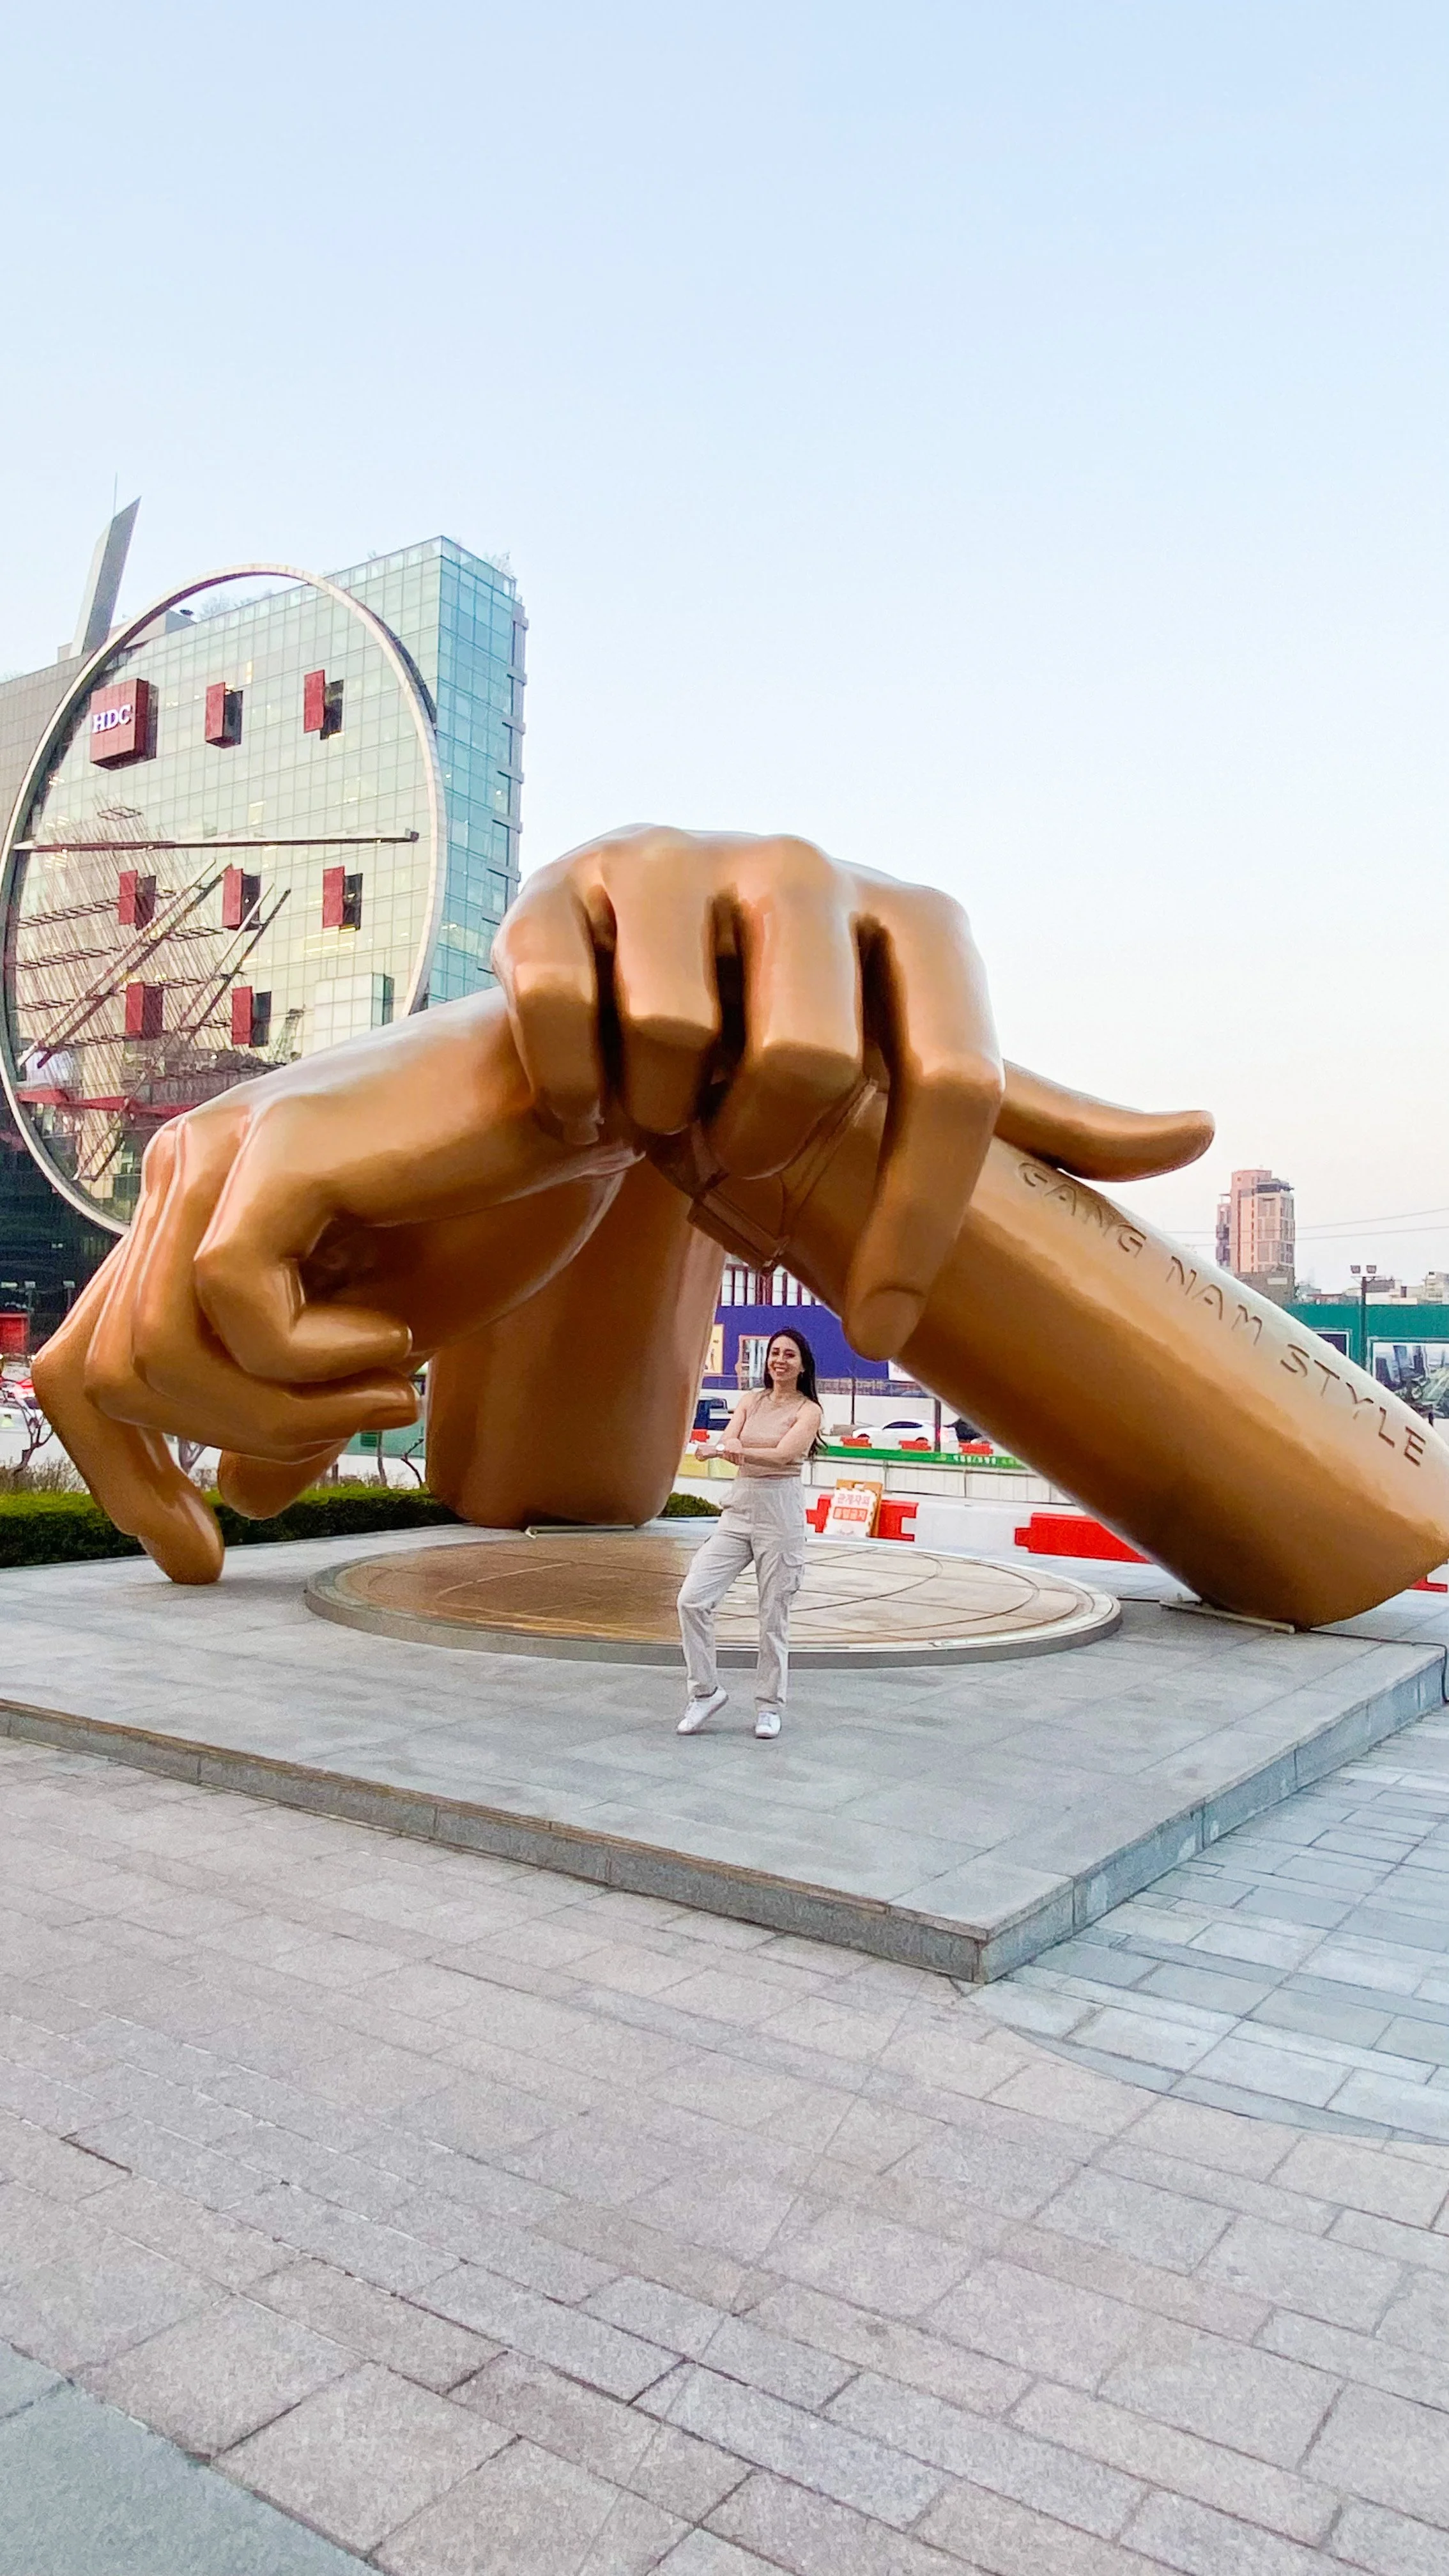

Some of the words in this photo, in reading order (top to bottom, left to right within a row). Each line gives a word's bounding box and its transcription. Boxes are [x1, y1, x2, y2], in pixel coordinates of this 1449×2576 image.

[92, 703, 132, 734] HDC
[1018, 1162, 1147, 1259] GANG
[1165, 1255, 1263, 1347] NAM
[1280, 1343, 1427, 1468] STYLE
